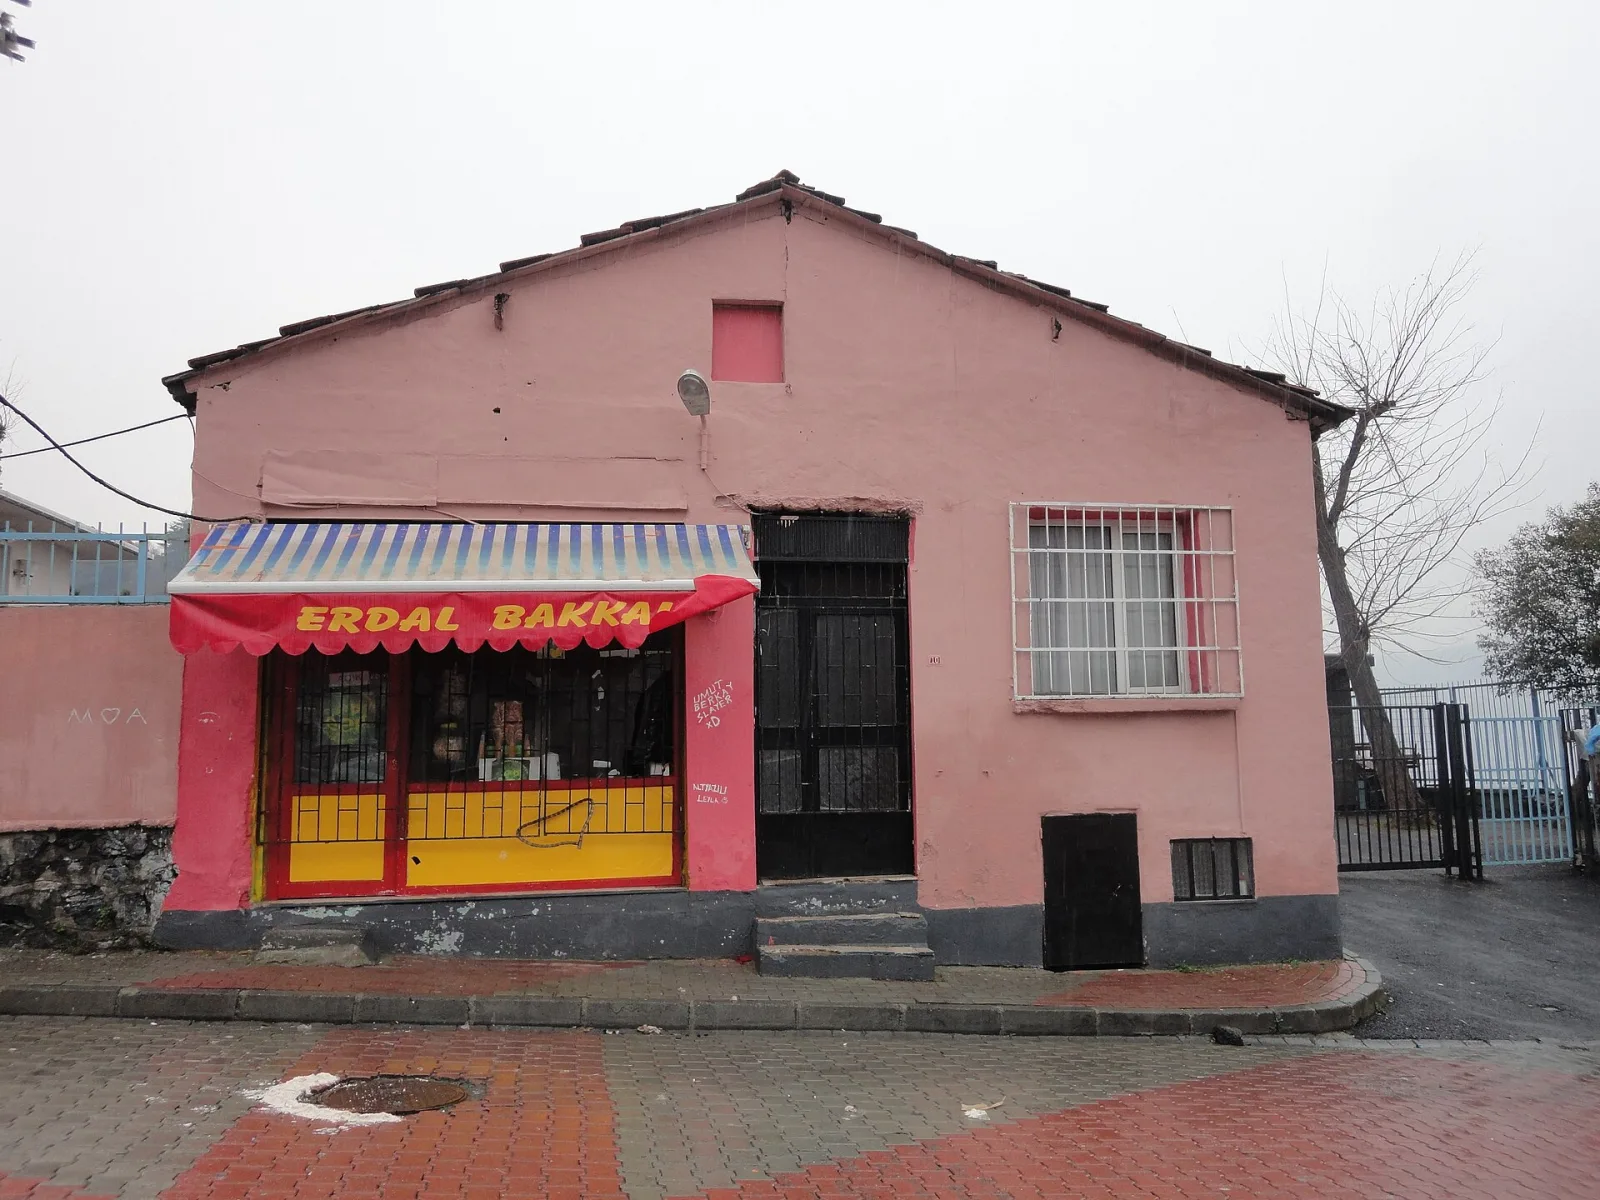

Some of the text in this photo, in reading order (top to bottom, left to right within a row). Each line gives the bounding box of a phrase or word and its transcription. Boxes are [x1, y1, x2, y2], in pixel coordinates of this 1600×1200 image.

[296, 606, 460, 634] ERDAL
[693, 679, 723, 704] UMUT
[693, 681, 734, 712] BERKAY
[67, 708, 148, 725] M A
[697, 694, 733, 724] SLAYER
